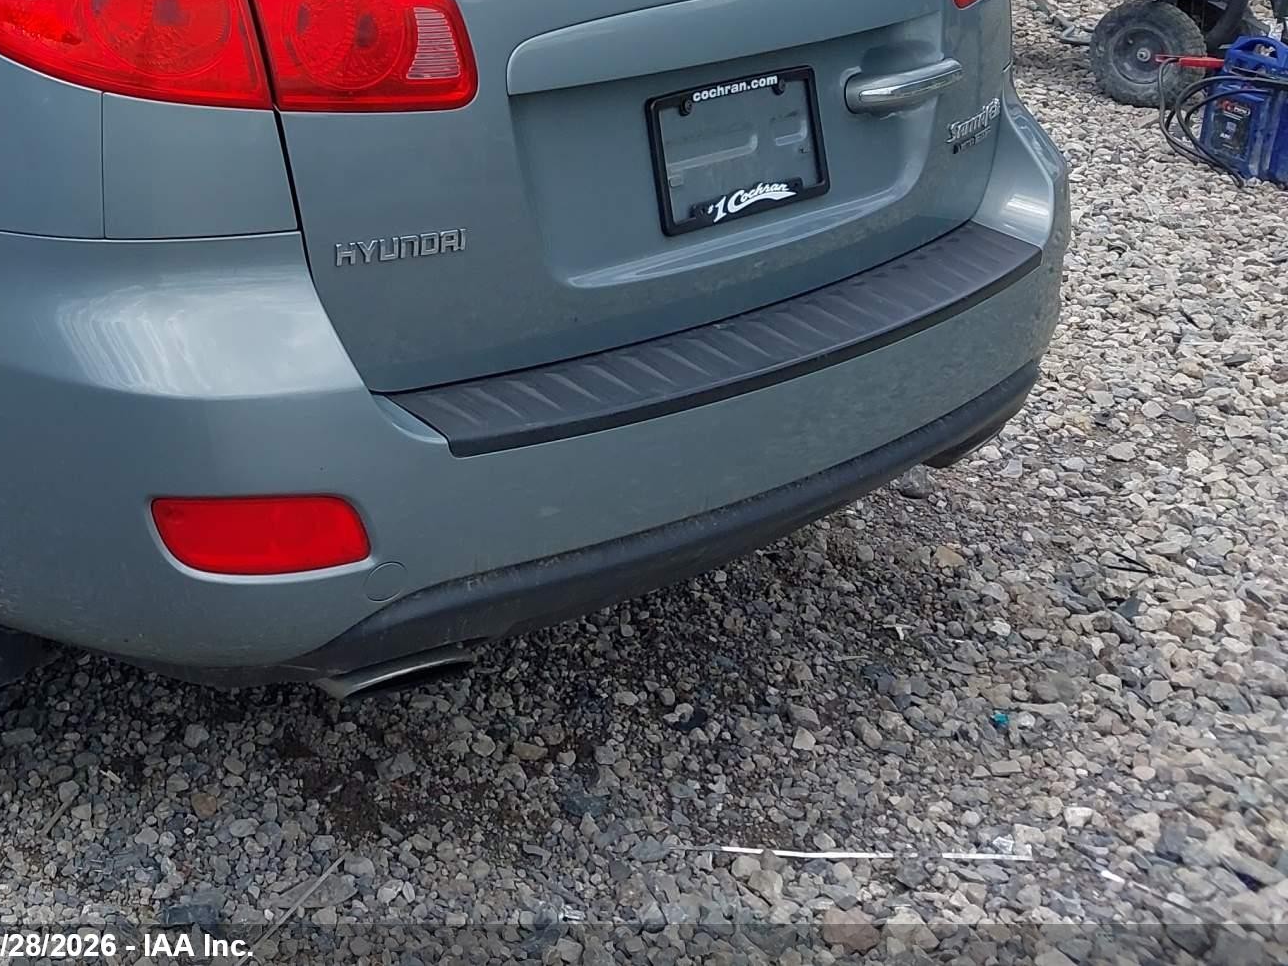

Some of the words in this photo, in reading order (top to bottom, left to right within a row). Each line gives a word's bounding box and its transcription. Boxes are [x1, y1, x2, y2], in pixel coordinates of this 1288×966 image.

[692, 75, 778, 102] cochran.com
[727, 182, 797, 214] Cochran
[335, 228, 467, 267] HYUNDAI
